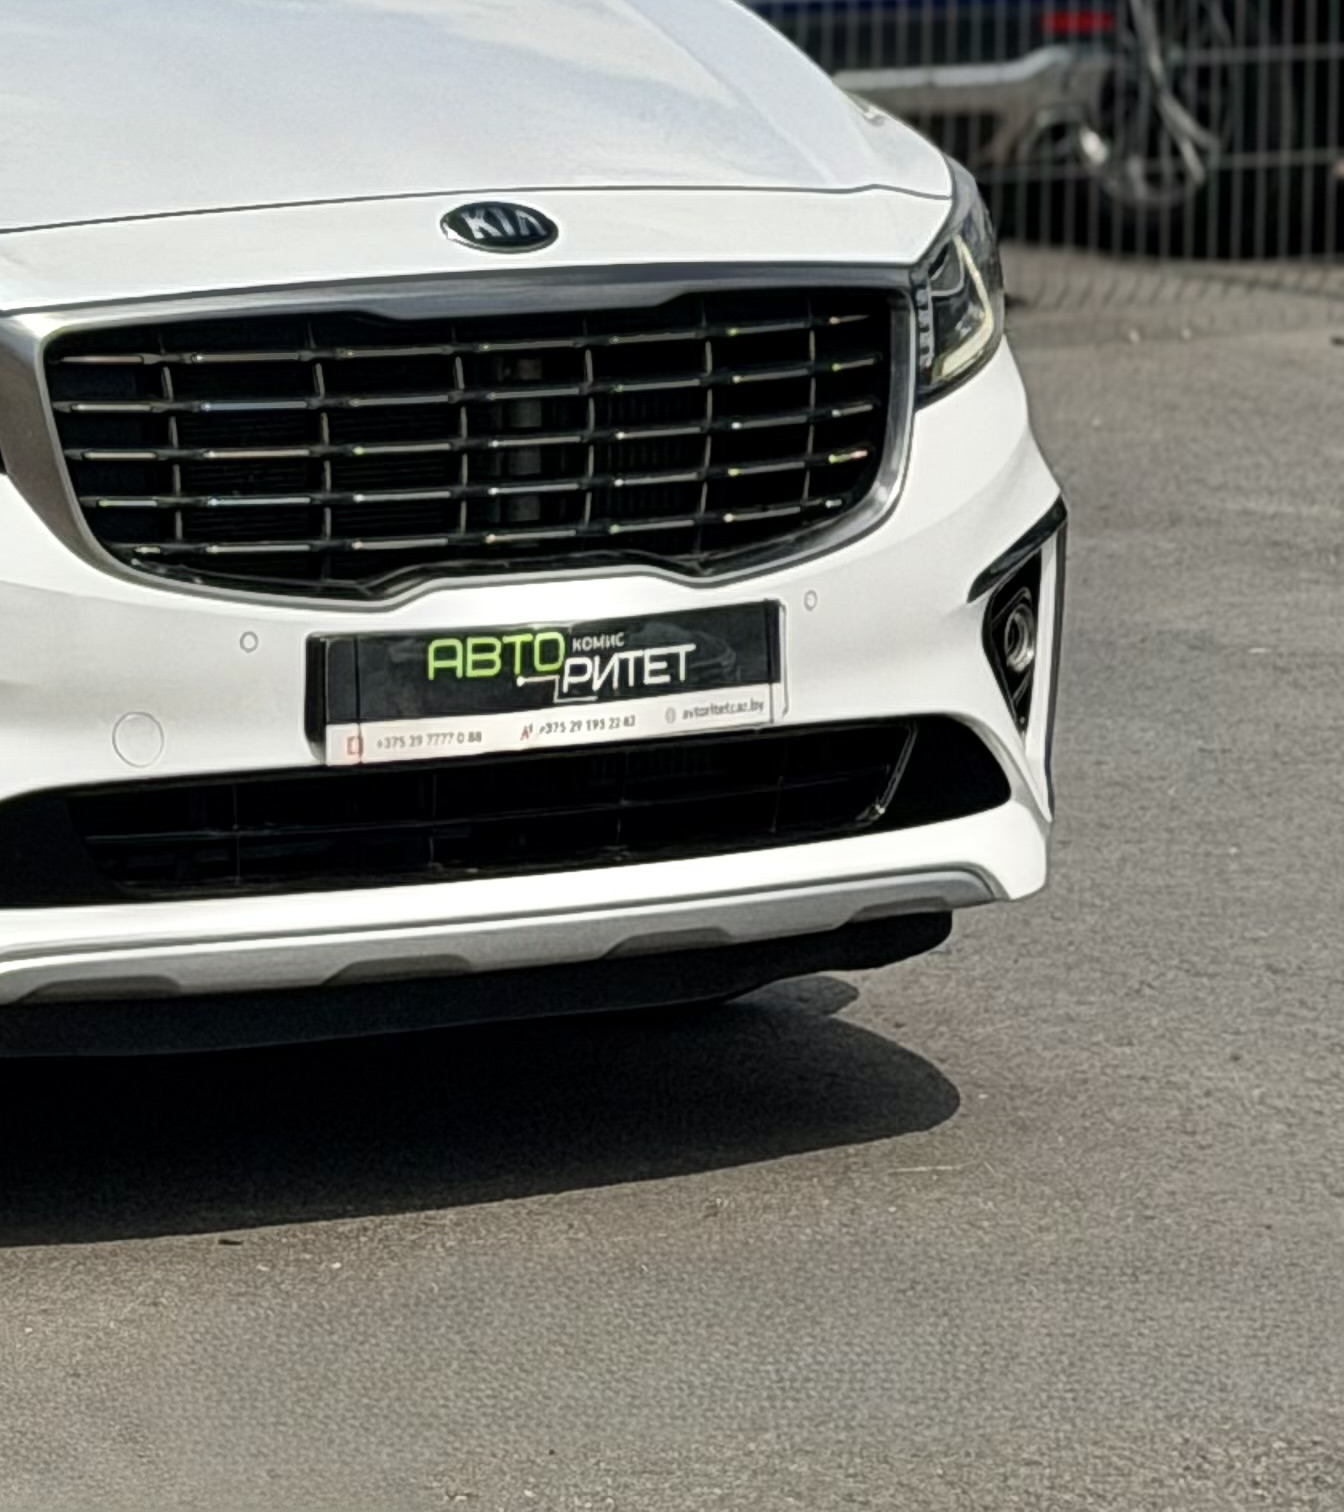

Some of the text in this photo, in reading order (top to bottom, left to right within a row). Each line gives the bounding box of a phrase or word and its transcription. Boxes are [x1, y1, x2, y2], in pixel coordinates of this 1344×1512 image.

[460, 206, 548, 240] KIA
[427, 631, 566, 681] АВТО
[571, 632, 625, 653] КОМИС
[561, 643, 697, 694] РИТЕТ
